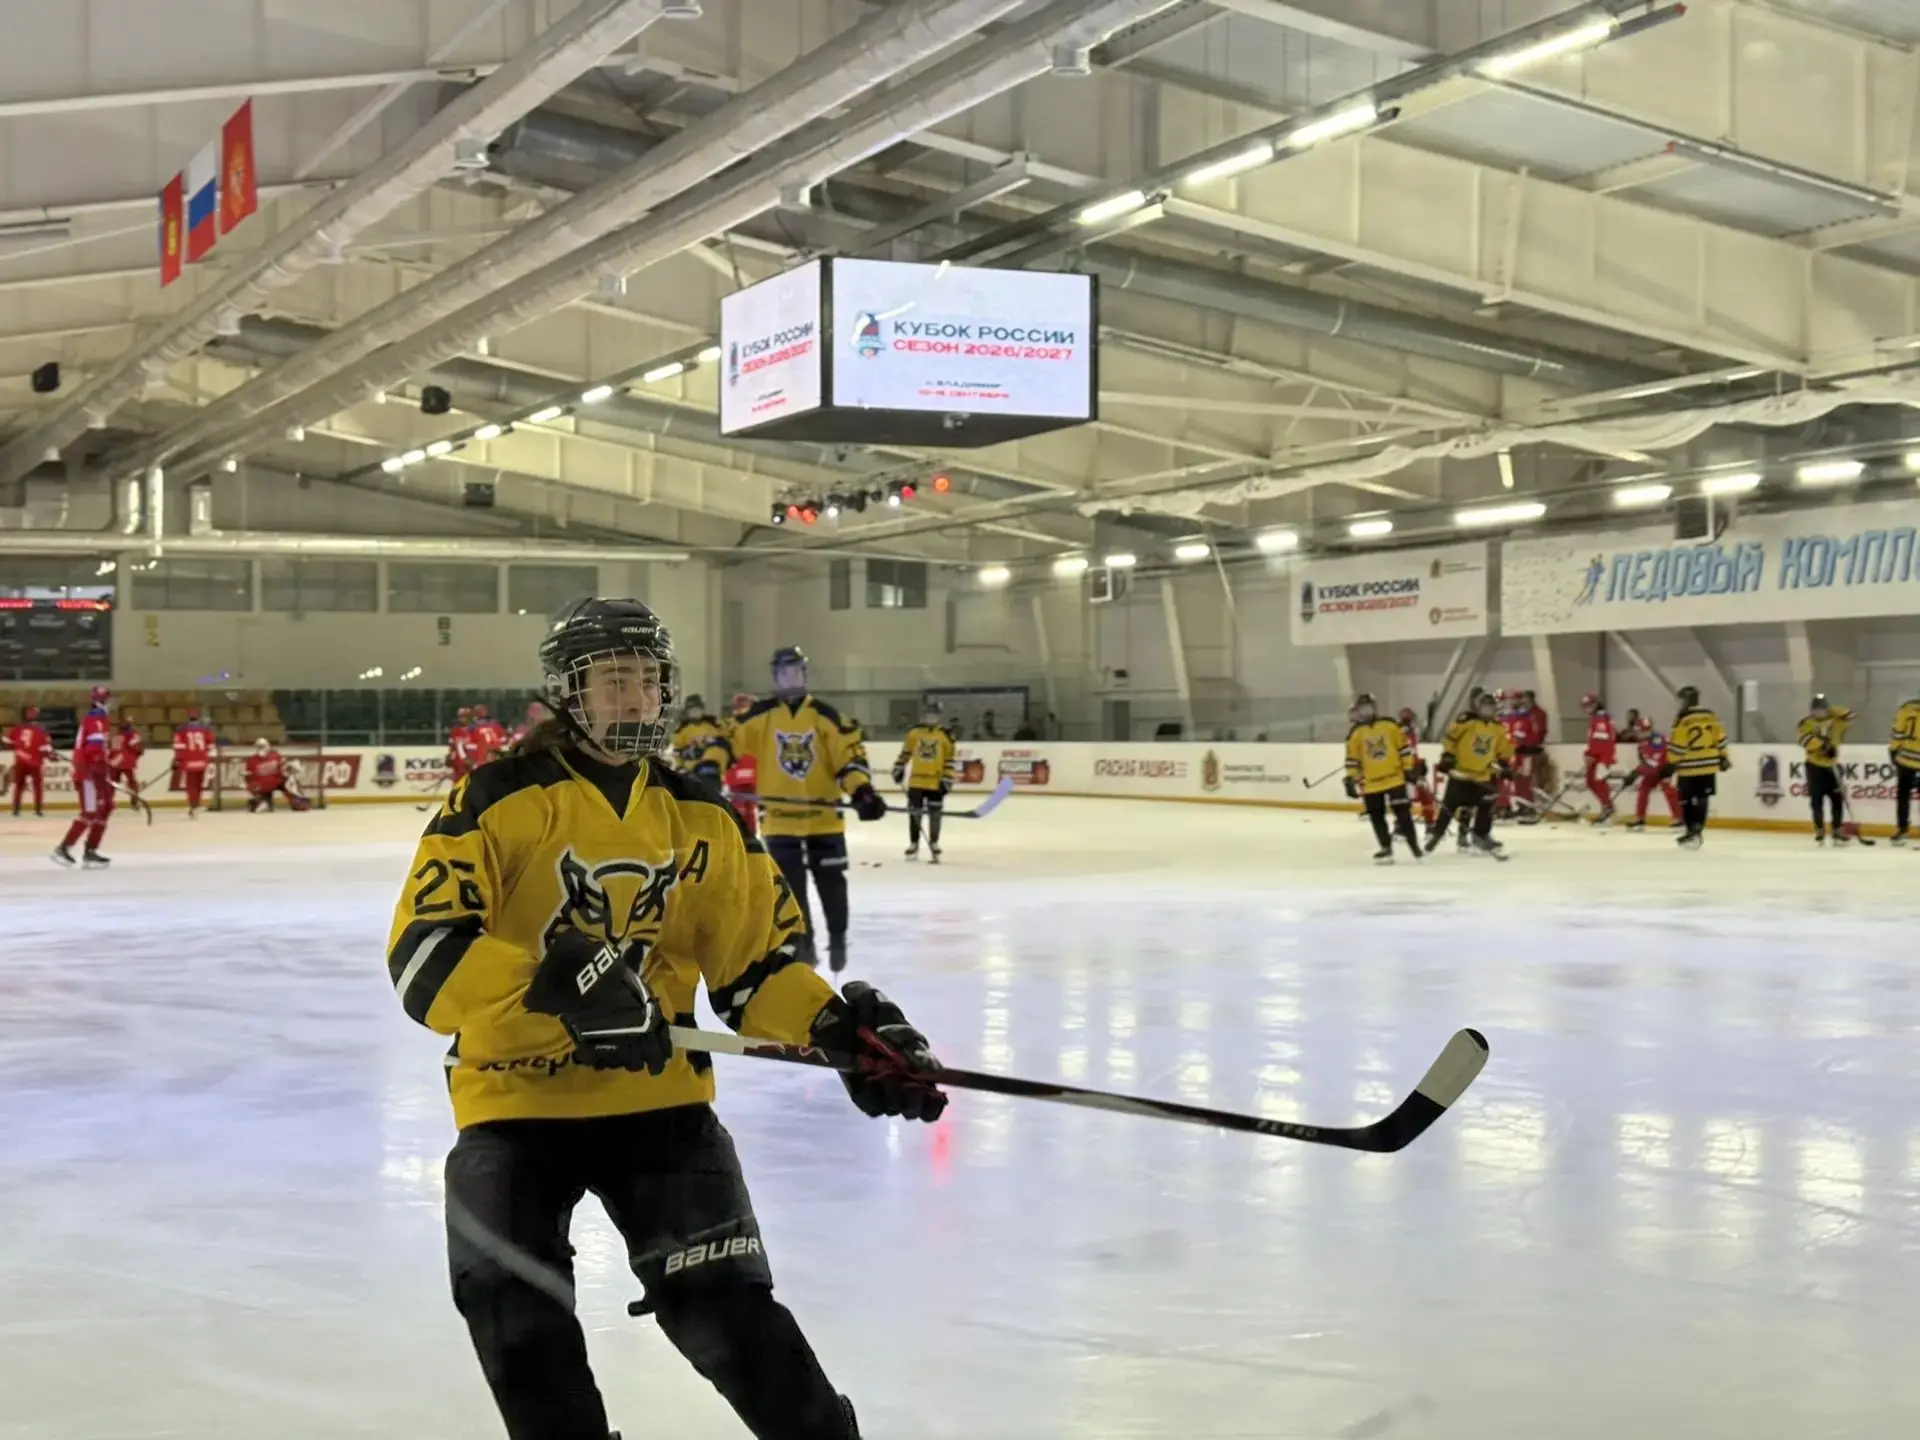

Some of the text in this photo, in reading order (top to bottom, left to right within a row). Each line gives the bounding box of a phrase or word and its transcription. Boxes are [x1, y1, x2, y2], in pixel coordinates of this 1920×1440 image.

[894, 321, 1075, 344] КУБОК РОССИИ
[893, 339, 1073, 360] СЕЗОН 2026/2027
[1778, 526, 1920, 590] КОМПЛ
